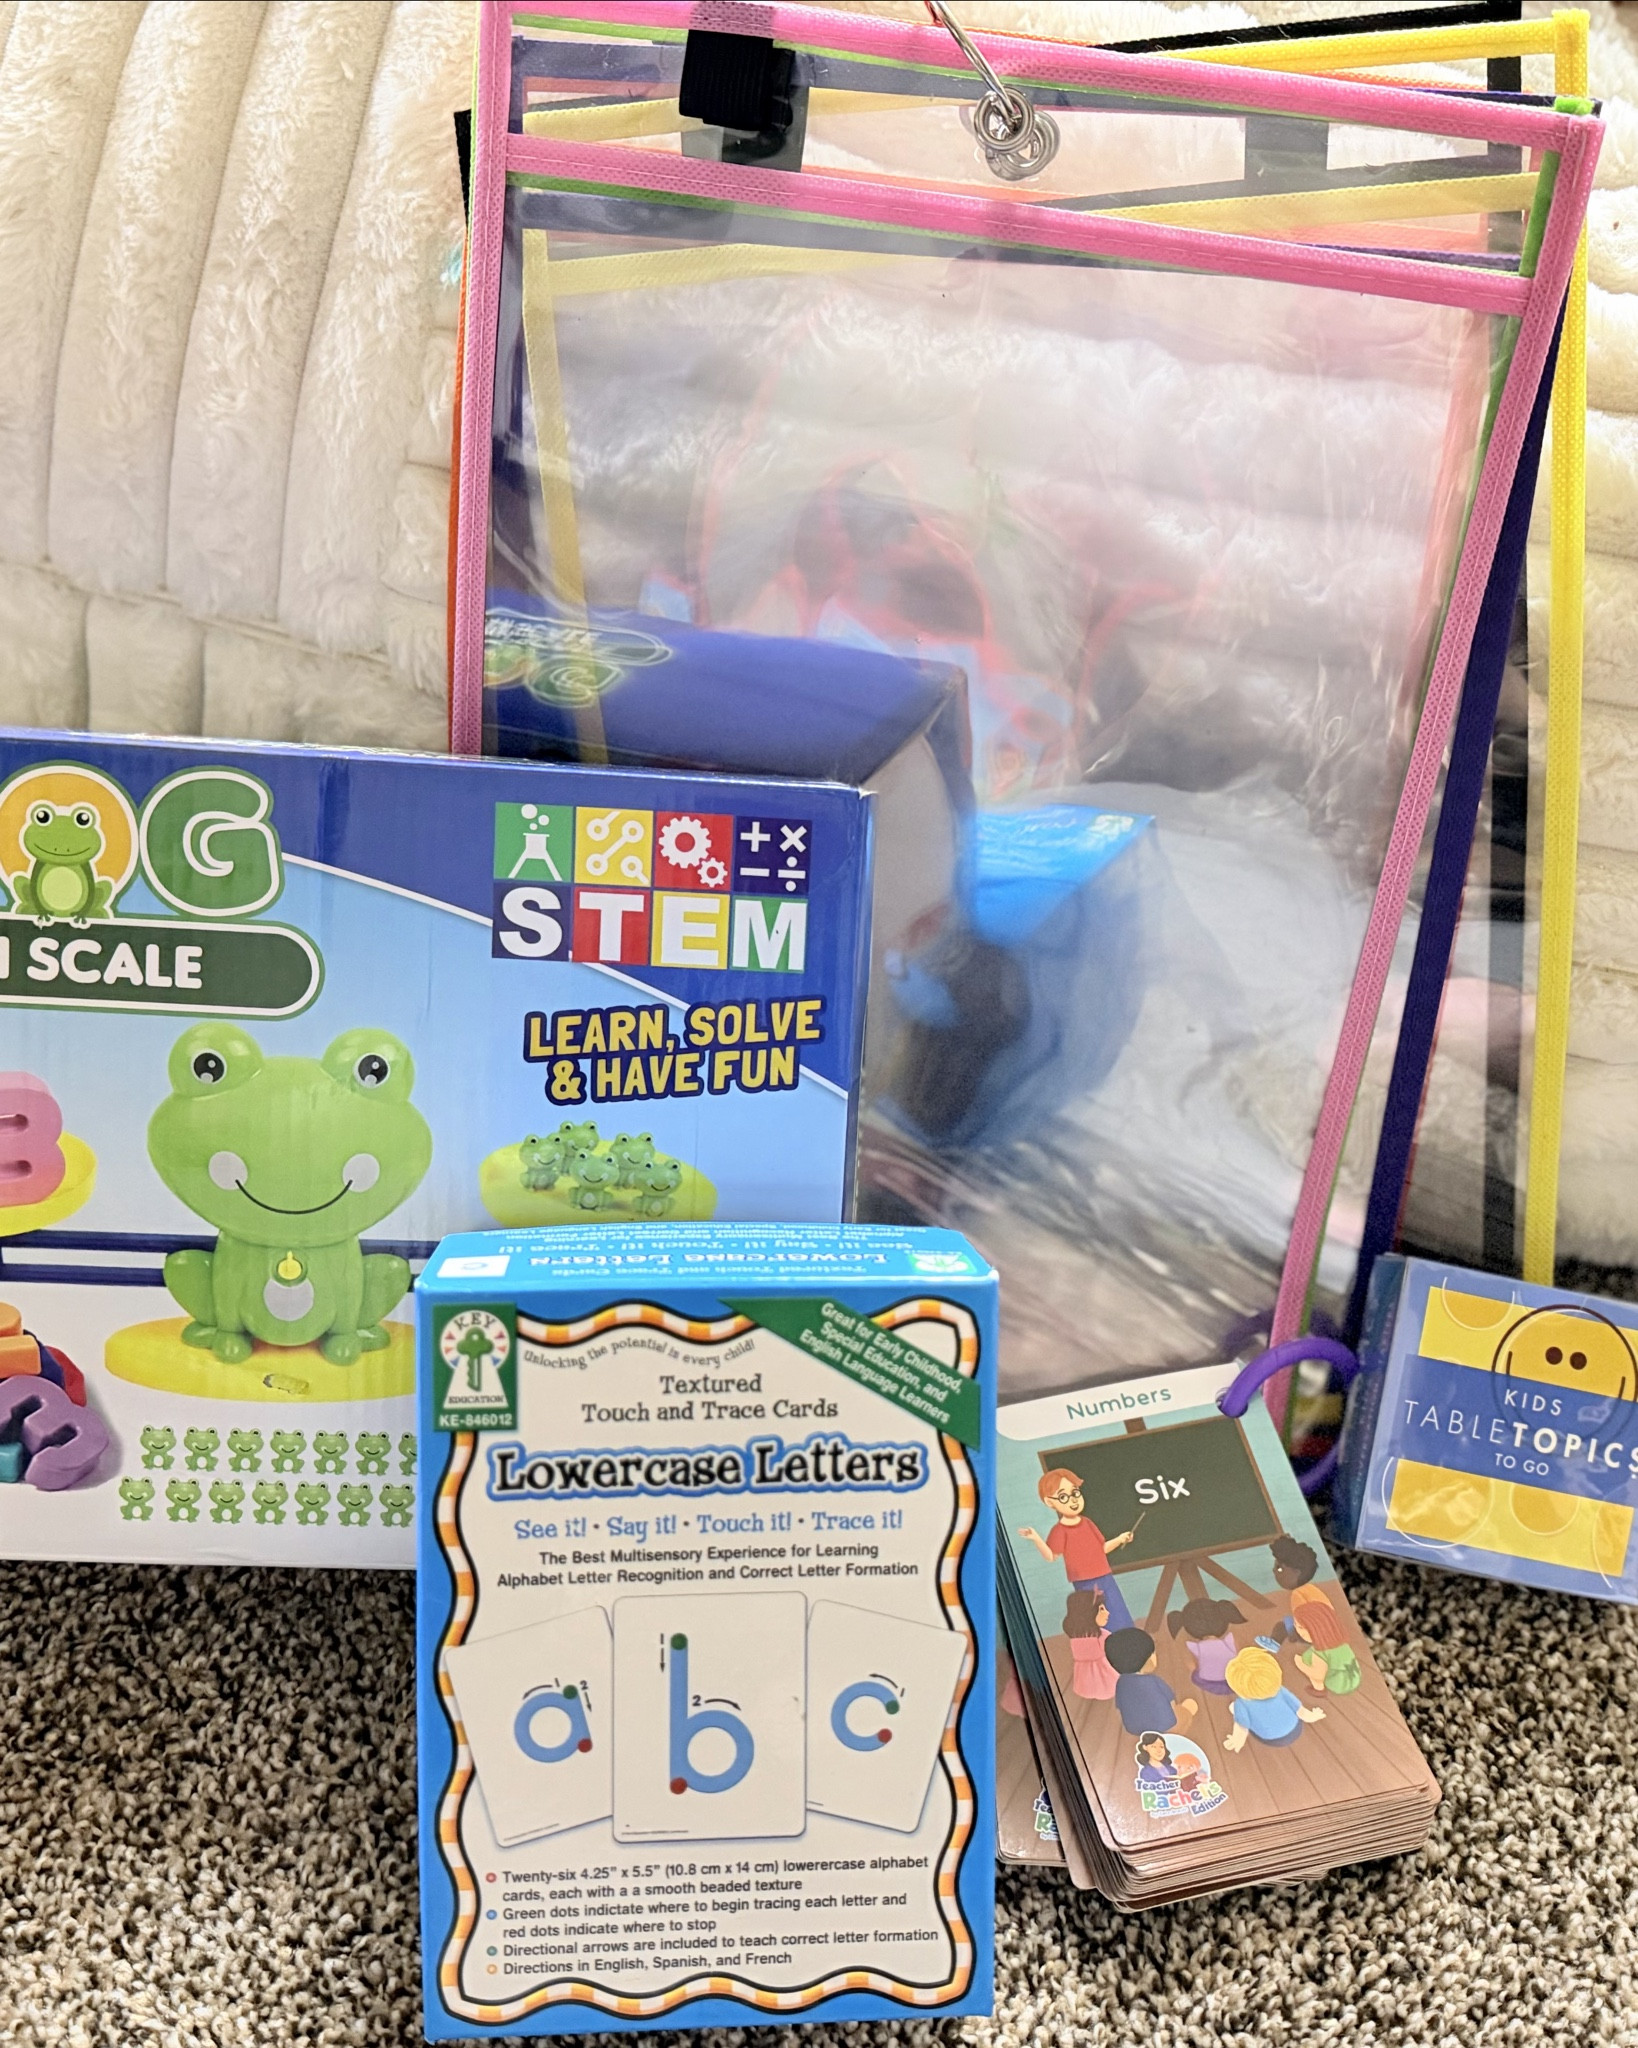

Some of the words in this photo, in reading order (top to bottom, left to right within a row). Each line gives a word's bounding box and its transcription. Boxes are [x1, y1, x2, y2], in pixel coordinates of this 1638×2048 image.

[499, 886, 807, 971] STEM
[26, 936, 203, 990] SCALE
[529, 1008, 675, 1056] LEARN,
[688, 1000, 822, 1046] SOLVE
[547, 1061, 583, 1101] &
[597, 1053, 700, 1097] HAVE
[713, 1045, 795, 1090] FUN
[455, 1312, 497, 1331] KEY
[523, 1350, 588, 1370] Unlocking
[588, 1345, 609, 1361] the
[611, 1336, 668, 1356] potential
[668, 1347, 680, 1360] in
[683, 1353, 721, 1369] every
[724, 1338, 756, 1362] child!
[820, 1321, 866, 1354] Special
[863, 1346, 921, 1390] Education,
[923, 1383, 949, 1403] and
[821, 1302, 856, 1330] Great
[855, 1321, 874, 1340] for
[873, 1332, 905, 1359] Early
[903, 1350, 963, 1394] Childhood,
[660, 1374, 763, 1394] Textured
[799, 1329, 844, 1362] English
[842, 1353, 900, 1394] Language
[898, 1386, 951, 1424] Learners
[448, 1395, 505, 1405] EDUCATION
[581, 1402, 650, 1423] Touch
[656, 1401, 694, 1421] and
[701, 1401, 766, 1420] Trace
[772, 1398, 839, 1419] Cards
[1065, 1385, 1173, 1421] Numbers
[1504, 1388, 1563, 1417] KIDS
[439, 1413, 513, 1428] KE-846012
[493, 1448, 747, 1495] Lowercase
[752, 1438, 924, 1487] Letters
[1494, 1452, 1517, 1469] TO
[1523, 1459, 1550, 1477] GO
[1134, 1475, 1191, 1506] Six
[513, 1518, 558, 1540] See
[564, 1516, 587, 1538] it!
[606, 1515, 648, 1544] Say
[655, 1514, 677, 1535] it!
[696, 1512, 765, 1534] Touch
[770, 1511, 792, 1532] it!
[811, 1511, 876, 1531] Trace
[882, 1508, 903, 1530] it!
[539, 1552, 567, 1565] The
[572, 1550, 606, 1564] Best
[610, 1548, 703, 1564] Multisensory
[707, 1545, 787, 1562] Experience
[791, 1543, 812, 1557] for
[816, 1542, 879, 1558] Learning
[497, 1573, 564, 1589] Alphabet
[568, 1570, 613, 1585] Letter
[617, 1568, 704, 1584] Recognition
[708, 1566, 736, 1580] and
[739, 1564, 793, 1579] Correct
[799, 1563, 841, 1578] Letter
[846, 1561, 919, 1577] Formation
[1136, 1780, 1181, 1791] Teacher
[1190, 1793, 1228, 1816] Edition
[502, 1870, 577, 1885] Twenty-six
[620, 1868, 629, 1878] x
[665, 1863, 697, 1879] (10.8
[700, 1863, 722, 1875] cm
[724, 1863, 733, 1873] x
[735, 1860, 751, 1873] 14
[754, 1859, 779, 1875] cm)
[870, 1856, 929, 1871] alphabet
[502, 1888, 546, 1902] cards,
[549, 1886, 583, 1900] each
[586, 1885, 616, 1899] with
[619, 1887, 628, 1897] a
[632, 1886, 642, 1896] a
[645, 1881, 697, 1896] smooth
[700, 1879, 751, 1893] beaded
[754, 1878, 803, 1892] texture
[502, 1906, 546, 1920] Green
[549, 1903, 580, 1918] dots
[583, 1902, 645, 1917] indictate
[648, 1900, 691, 1914] where
[694, 1899, 708, 1913] to
[711, 1898, 750, 1914] begin
[753, 1896, 801, 1912] tracing
[804, 1894, 838, 1909] each
[841, 1893, 879, 1907] letter
[882, 1892, 908, 1906] and
[502, 1925, 527, 1939] red
[530, 1924, 561, 1938] dots
[563, 1921, 619, 1937] indicate
[622, 1919, 666, 1933] where
[669, 1919, 684, 1932] to
[687, 1918, 717, 1933] stop
[503, 1942, 578, 1957] Directional
[582, 1941, 630, 1954] arrows
[633, 1941, 656, 1952] are
[659, 1936, 718, 1951] included
[721, 1935, 736, 1949] to
[739, 1933, 778, 1947] teach
[780, 1932, 830, 1946] correct
[832, 1930, 870, 1944] letter
[872, 1928, 939, 1943] formation
[503, 1960, 574, 1975] Directions
[577, 1958, 591, 1971] in
[594, 1956, 650, 1973] English,
[652, 1954, 712, 1970] Spanish,
[715, 1952, 742, 1966] and
[745, 1951, 793, 1965] French
